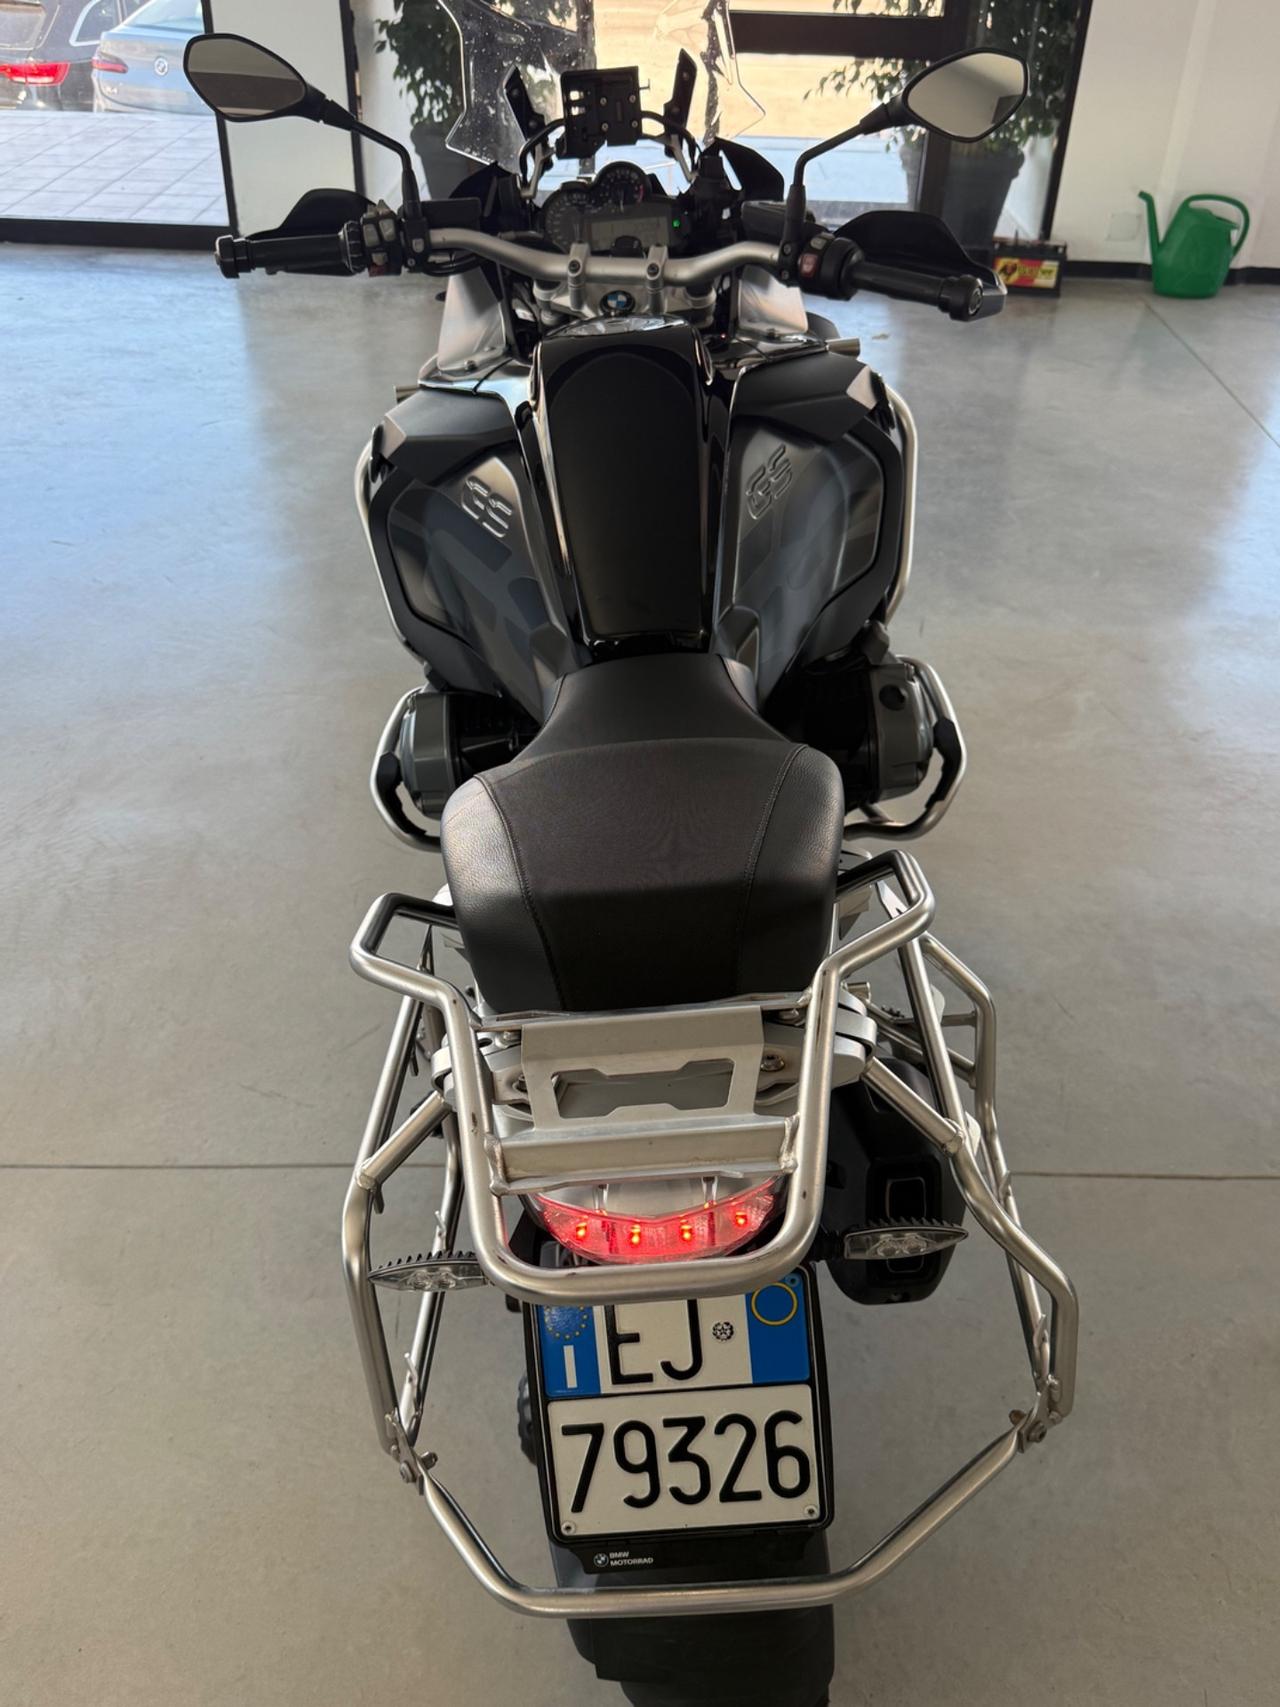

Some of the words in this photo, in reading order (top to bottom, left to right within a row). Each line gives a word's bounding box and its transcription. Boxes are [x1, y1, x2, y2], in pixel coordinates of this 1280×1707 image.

[745, 442, 794, 520] GS
[603, 1299, 704, 1385] EJ
[561, 1409, 812, 1514] 79326
[609, 1551, 630, 1559] BMW
[610, 1557, 654, 1566] MOTORRAD
